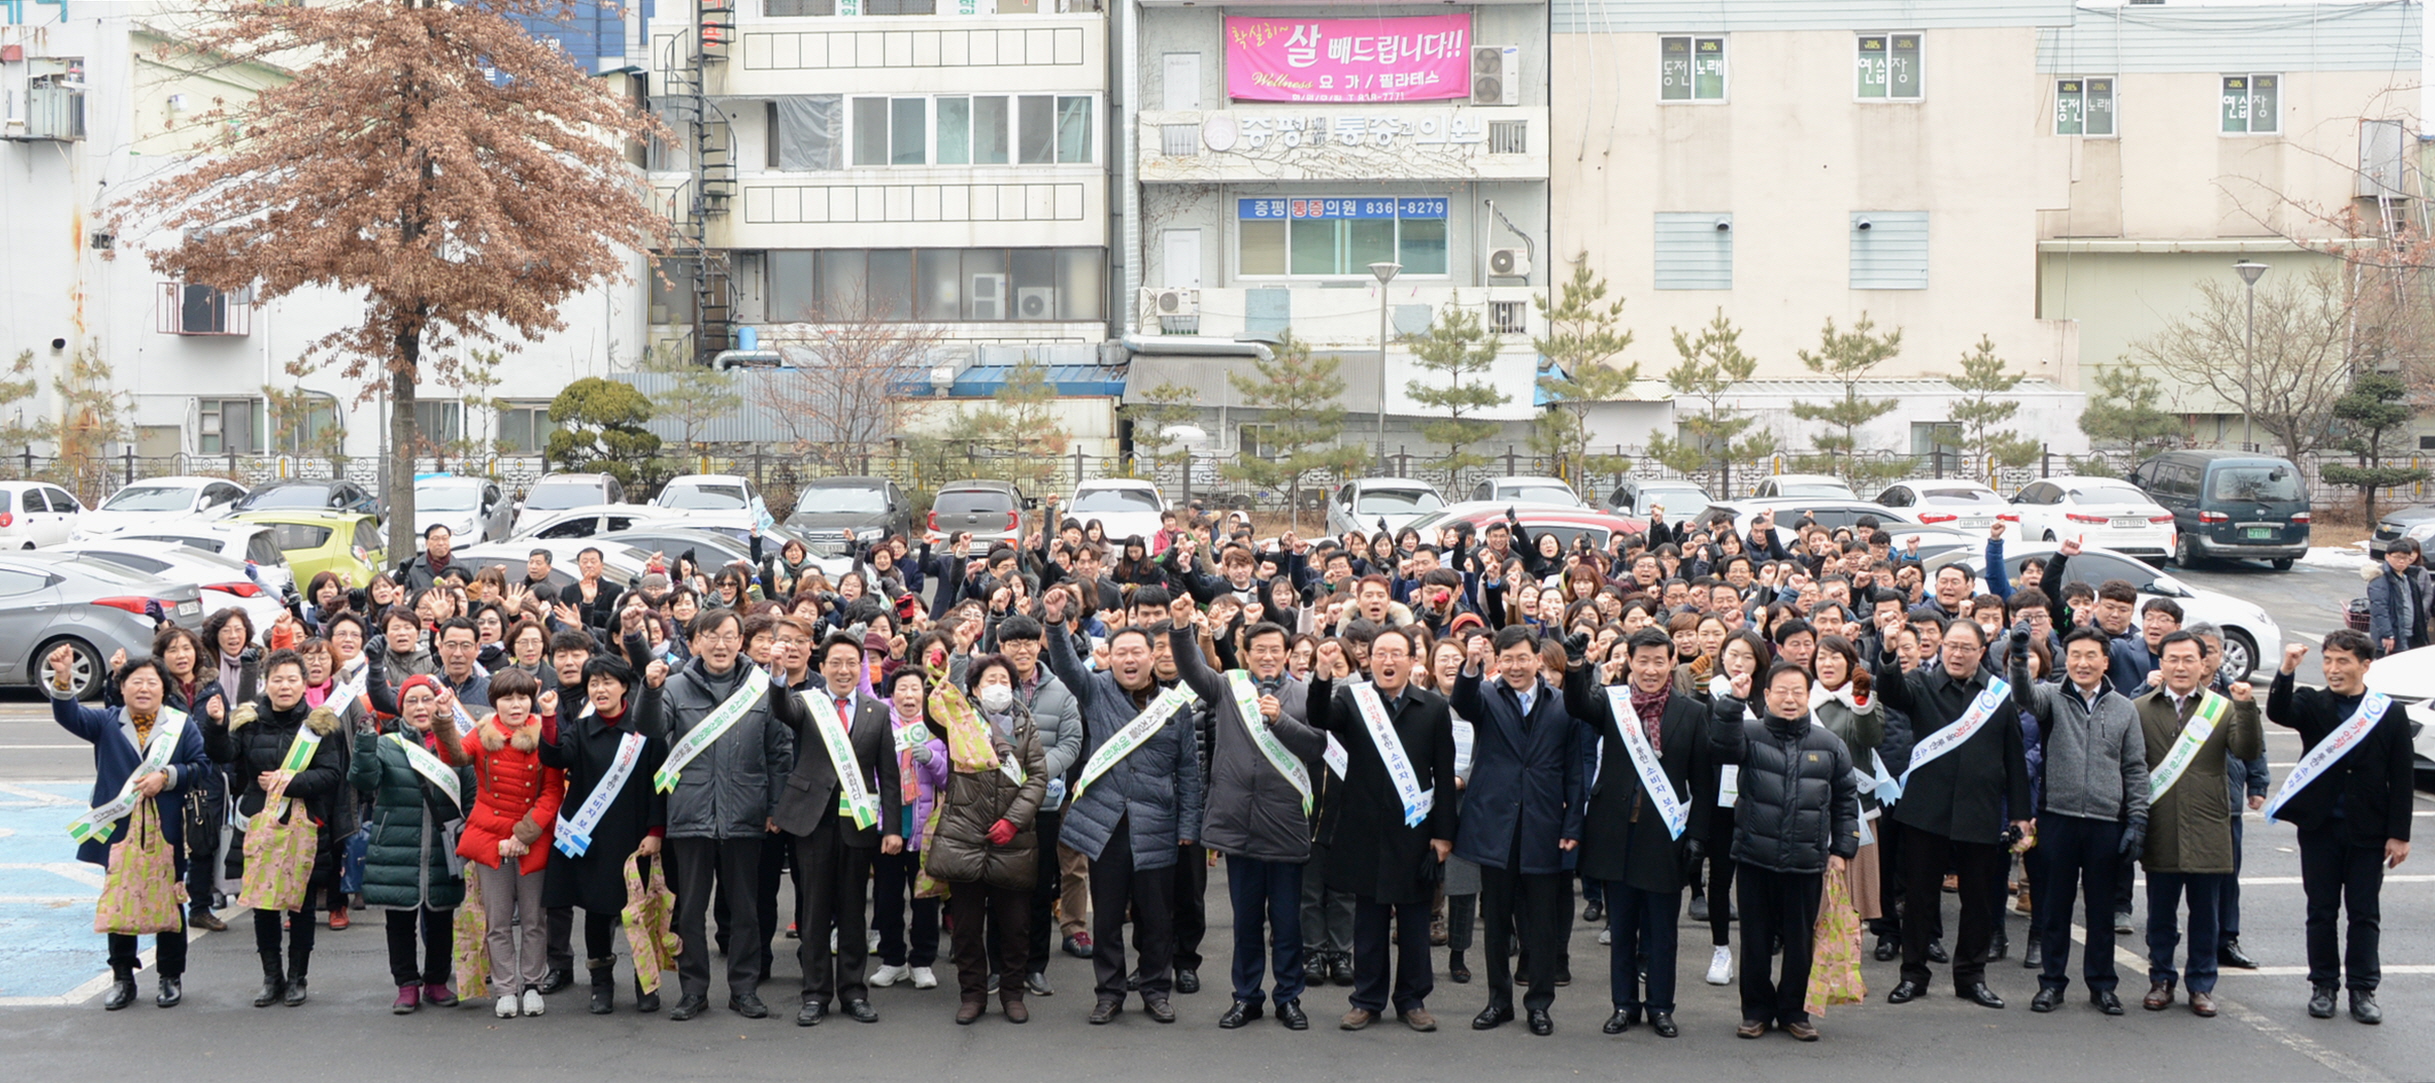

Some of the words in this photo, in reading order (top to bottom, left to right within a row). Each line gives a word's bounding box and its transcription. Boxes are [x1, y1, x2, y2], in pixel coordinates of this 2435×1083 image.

[1284, 24, 1321, 68] 살
[1327, 29, 1464, 65] 빼드립니다!!
[1252, 71, 1314, 90] Wellness
[1379, 71, 1440, 88] 필라테스
[1663, 60, 1689, 87] 동전
[1696, 59, 1723, 76] 노래
[1858, 57, 1908, 84] 연습장
[2058, 98, 2082, 122] 동전
[2088, 98, 2112, 113] 노래
[2223, 95, 2268, 119] 연습장
[1242, 115, 1308, 147] 증평
[1254, 200, 1286, 217] 증평
[1292, 199, 1357, 218] 통증의원
[1366, 201, 1444, 214] 836-8279
[1089, 735, 1131, 774] 애용합시다
[1391, 753, 1409, 780] 소비자
[1646, 767, 1667, 794] 소비자
[2288, 767, 2309, 789] 소비자
[586, 793, 607, 819] 소비자
